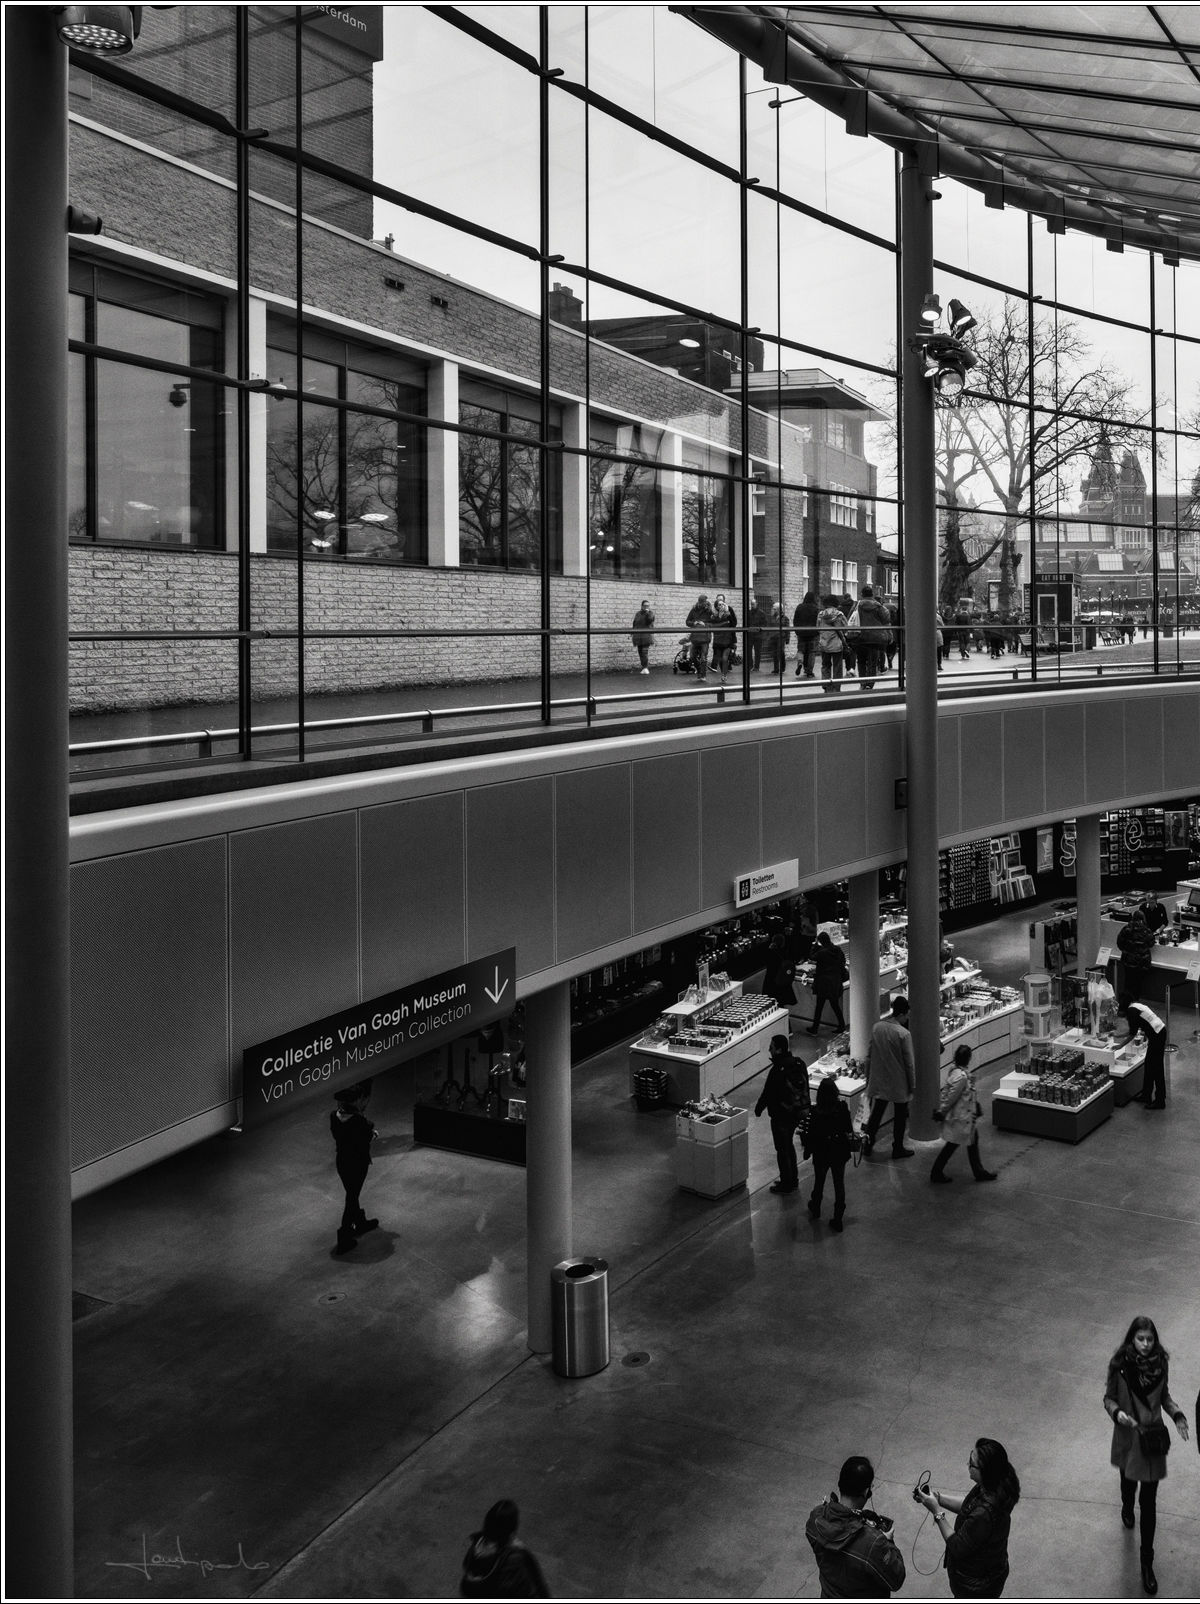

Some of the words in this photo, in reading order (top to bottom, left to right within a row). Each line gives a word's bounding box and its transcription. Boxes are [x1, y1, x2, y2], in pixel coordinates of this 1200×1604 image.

[312, 5, 367, 32] sterdam
[752, 873, 775, 886] Toiletten
[752, 882, 779, 896] Restrooms
[261, 1034, 333, 1077] Collectie
[337, 1020, 367, 1044] Van
[371, 1003, 409, 1032] Gogh
[413, 982, 467, 1015] Museum
[261, 1078, 294, 1103] Van
[299, 1056, 341, 1087] Gogh
[346, 1033, 404, 1067] Museum
[408, 1000, 472, 1039] Collection
